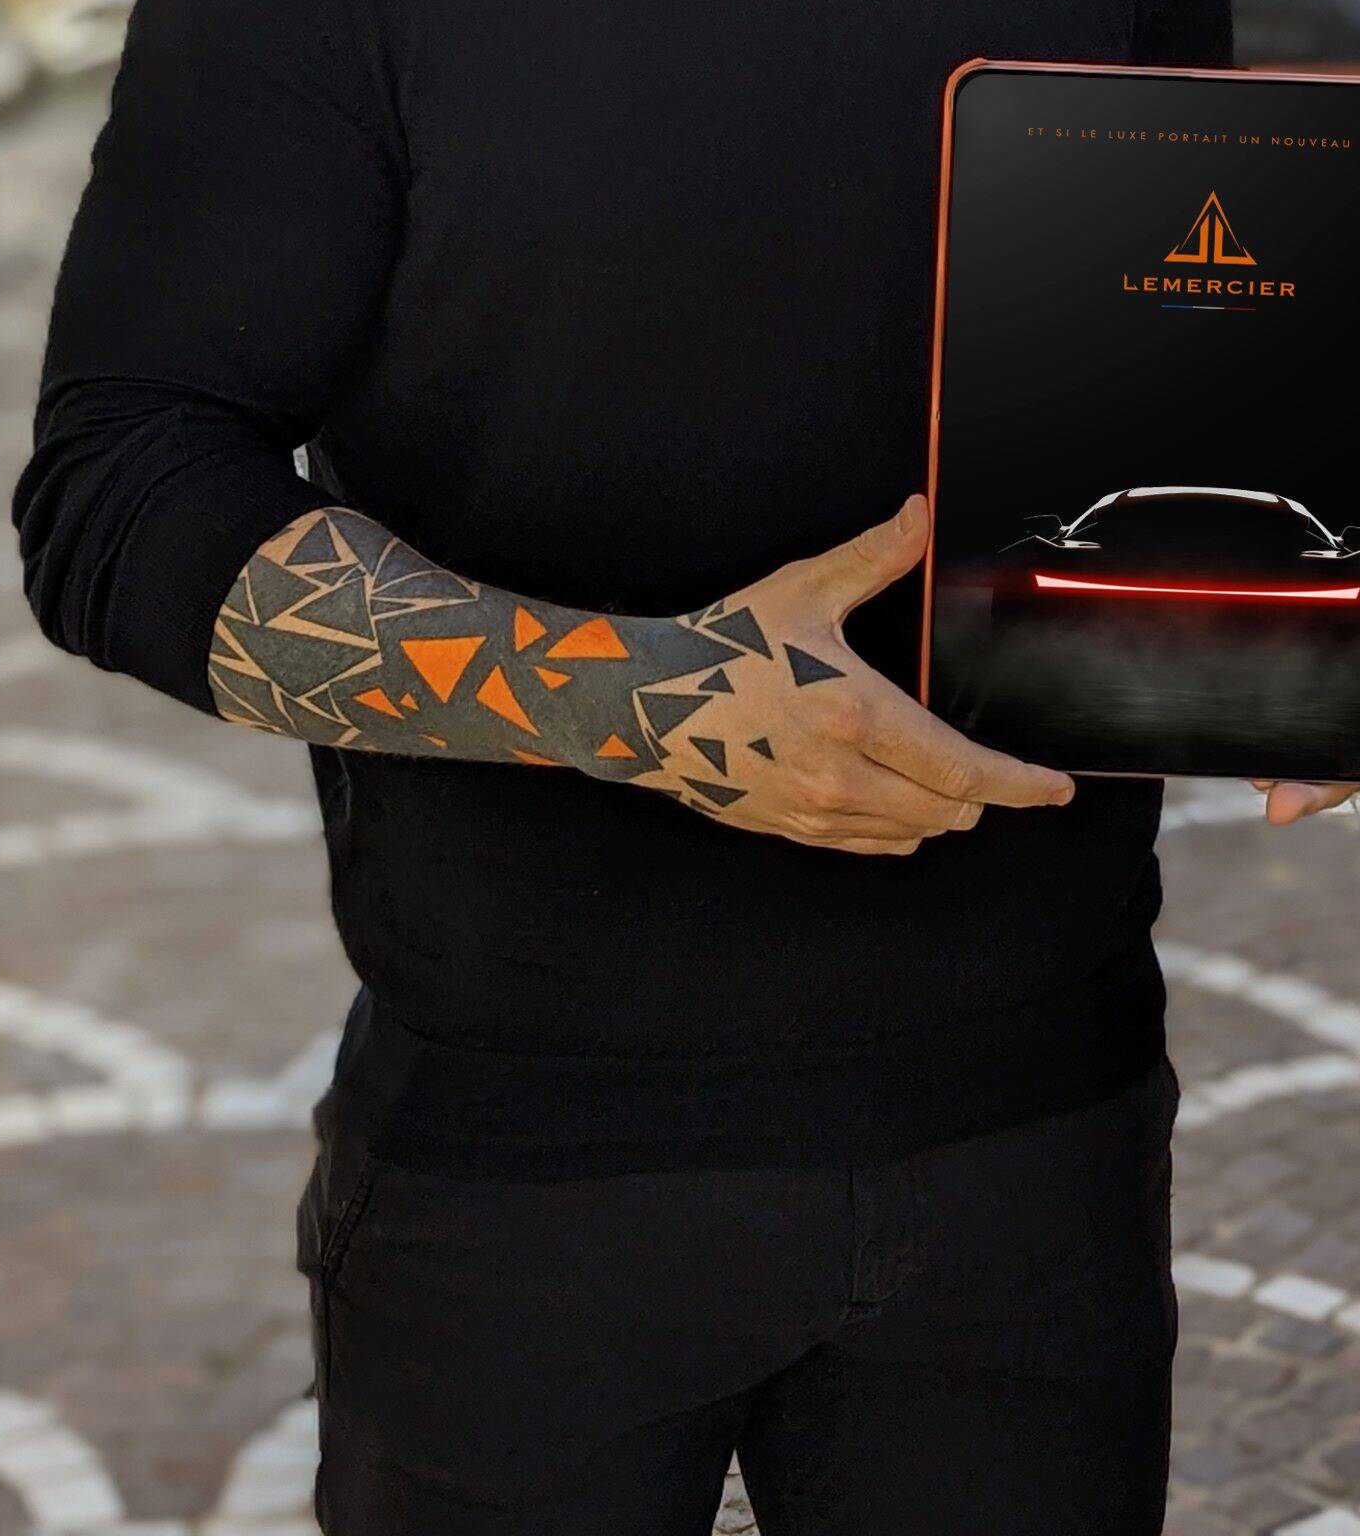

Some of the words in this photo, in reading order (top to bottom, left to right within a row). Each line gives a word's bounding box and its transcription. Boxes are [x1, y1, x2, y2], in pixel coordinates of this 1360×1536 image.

[1027, 127, 1044, 136] ET
[1055, 128, 1071, 137] SI
[1081, 129, 1098, 138] LE
[1108, 130, 1148, 141] LUXE
[1158, 131, 1228, 144] PORTAIT
[1239, 135, 1261, 145] UN
[1271, 136, 1352, 149] NOUVEAU
[1122, 272, 1296, 297] LEMERCIER
